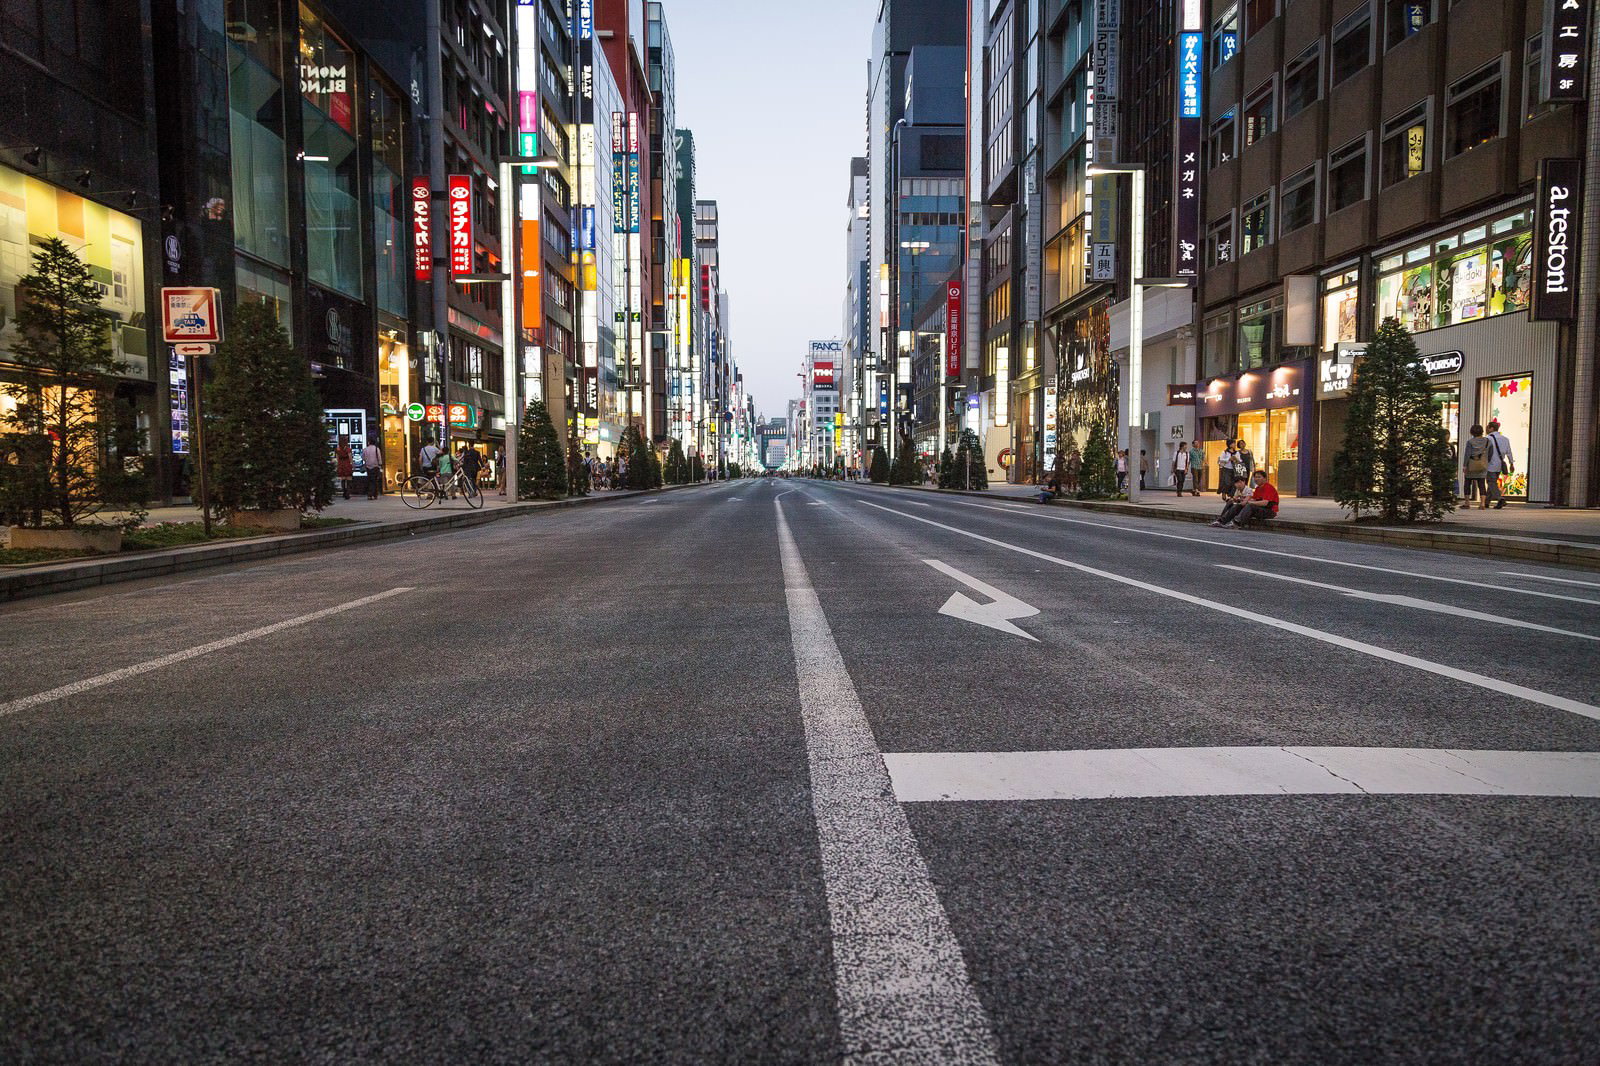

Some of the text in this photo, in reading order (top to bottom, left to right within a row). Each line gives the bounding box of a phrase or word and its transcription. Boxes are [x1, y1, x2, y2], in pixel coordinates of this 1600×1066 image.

[584, 65, 592, 99] BALLY
[1559, 79, 1575, 90] 3F
[1182, 152, 1195, 199] メガネ
[452, 201, 468, 246] タナカ
[1546, 186, 1571, 294] a.testoni
[812, 342, 842, 351] FANCL
[589, 377, 597, 409] BALLY
